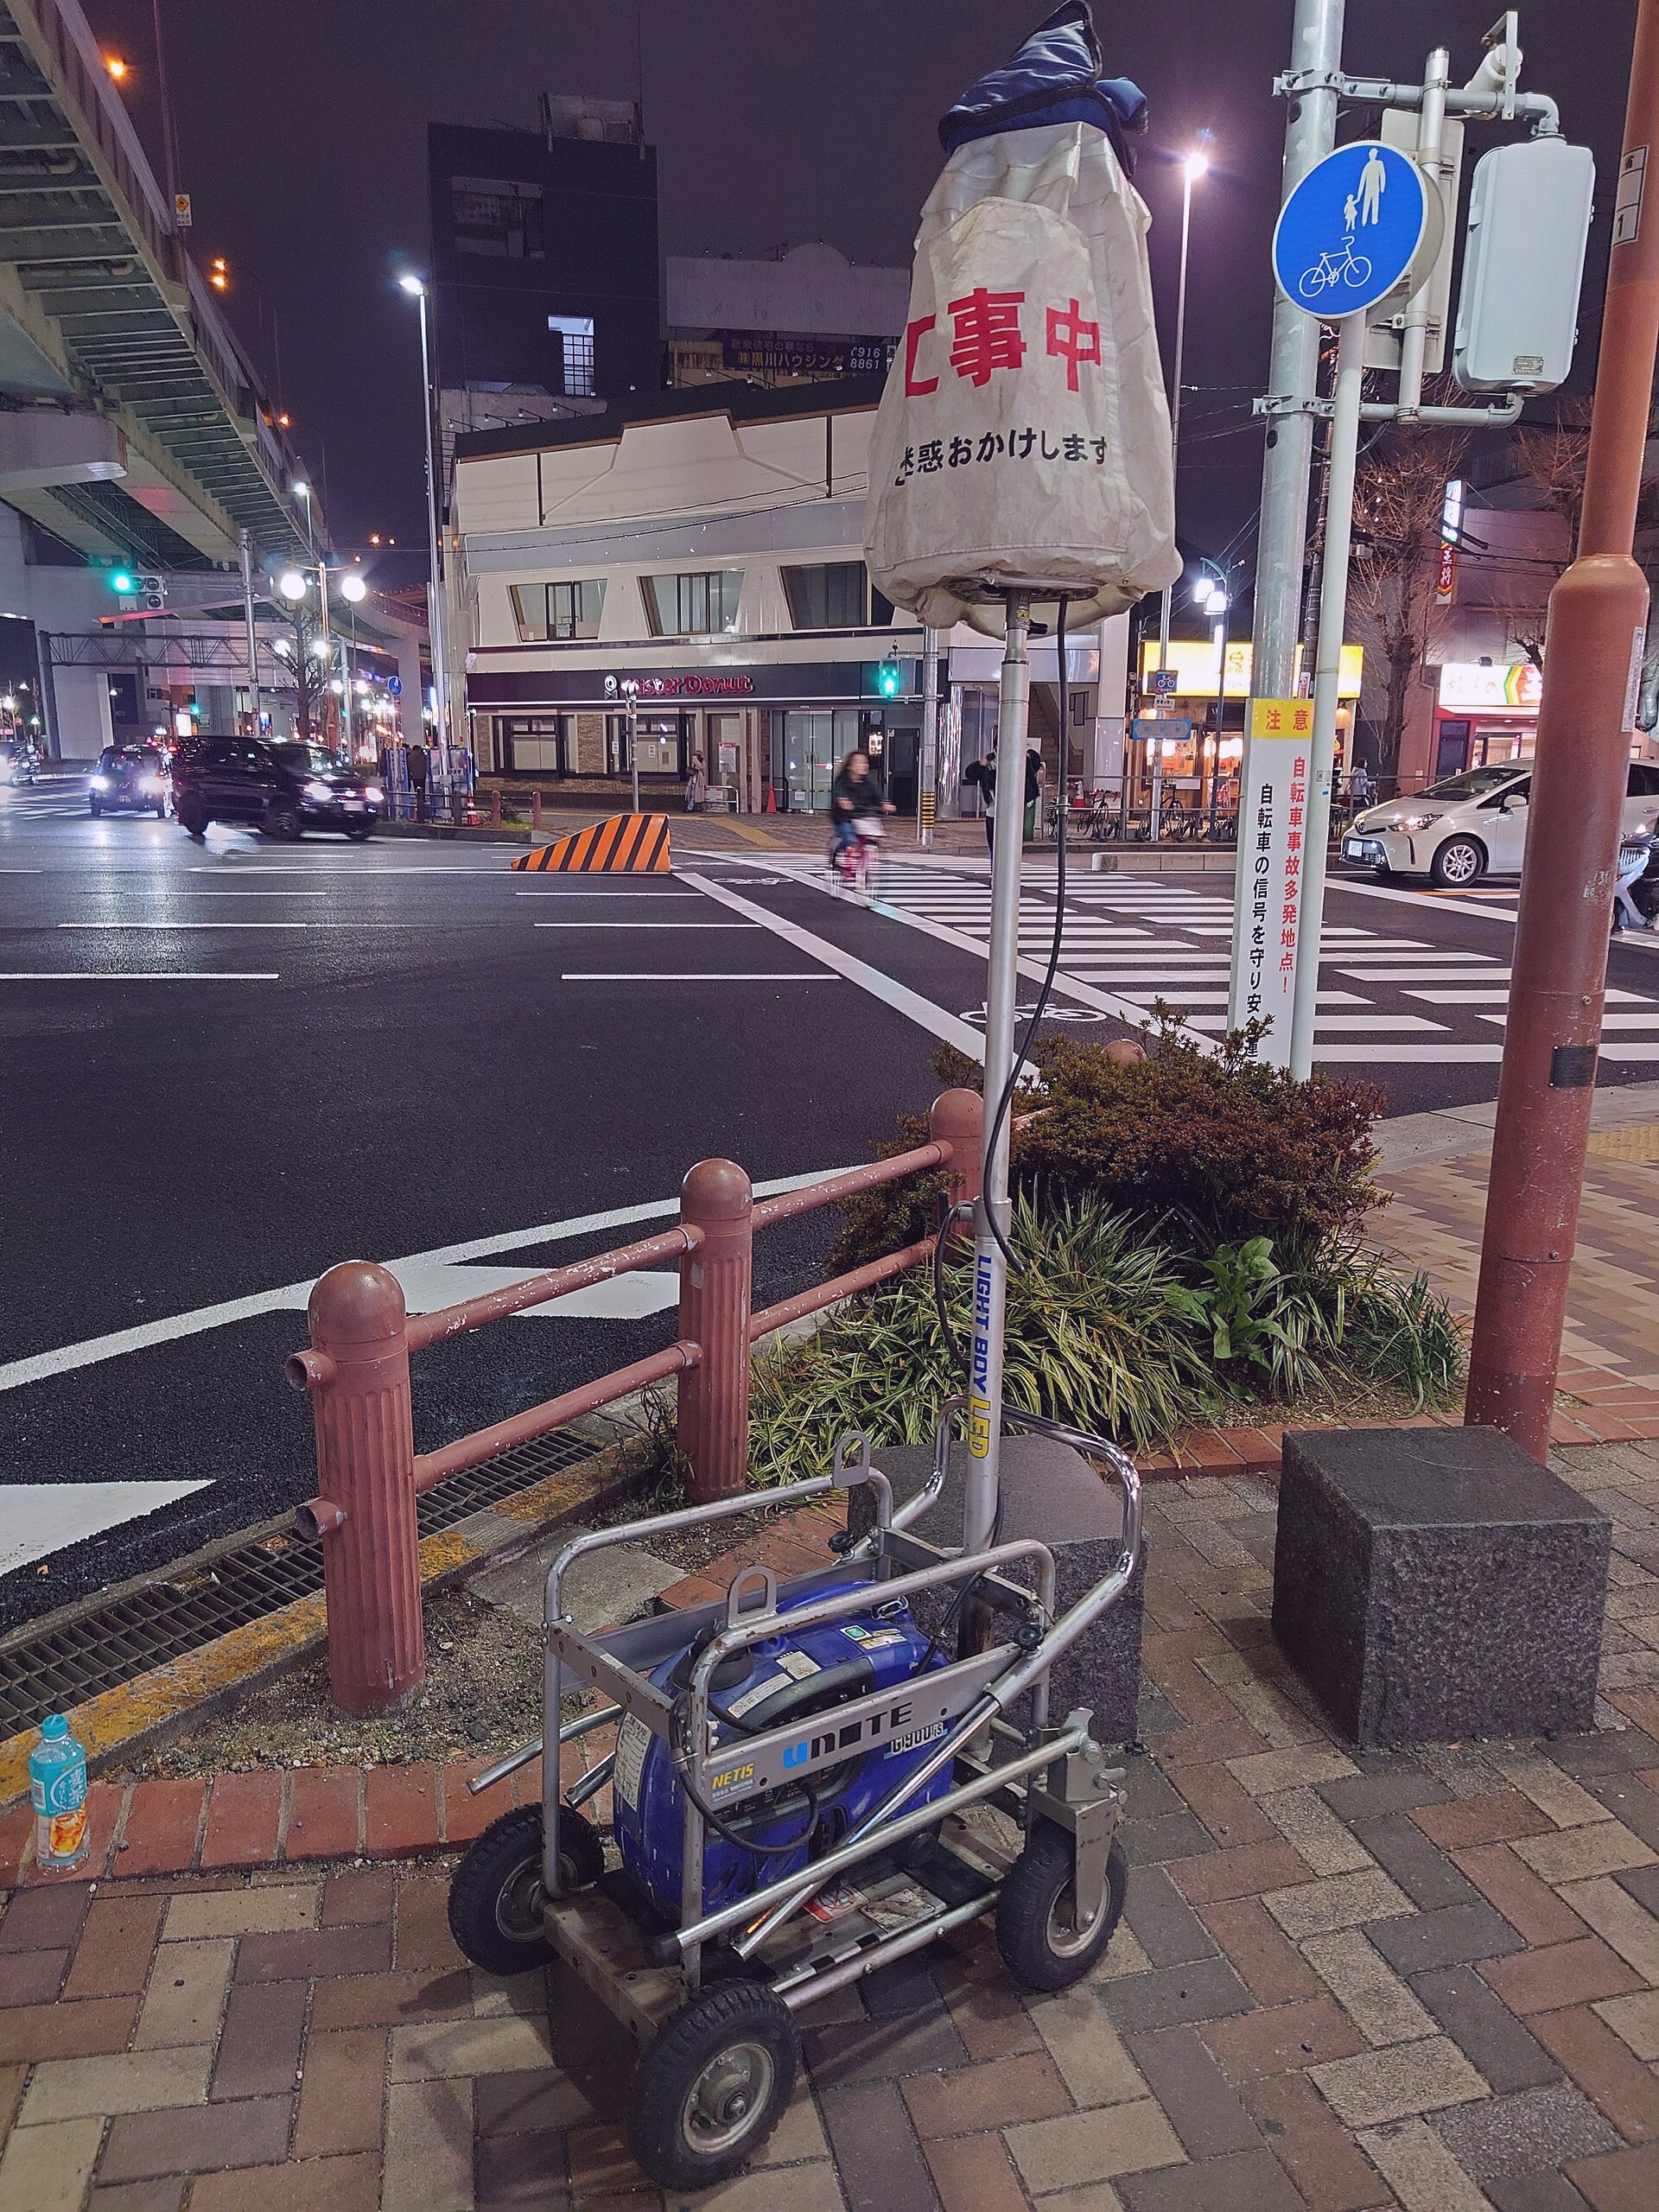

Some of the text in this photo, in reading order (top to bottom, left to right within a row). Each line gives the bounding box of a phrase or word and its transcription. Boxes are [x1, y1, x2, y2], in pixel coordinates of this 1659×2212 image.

[849, 358, 879, 369] 8861
[685, 674, 753, 695] Donut
[1265, 709, 1309, 731] 注意
[1279, 756, 1306, 994] 自転車事故多発地点！
[968, 1254, 992, 1459] LIGHT BOY LED
